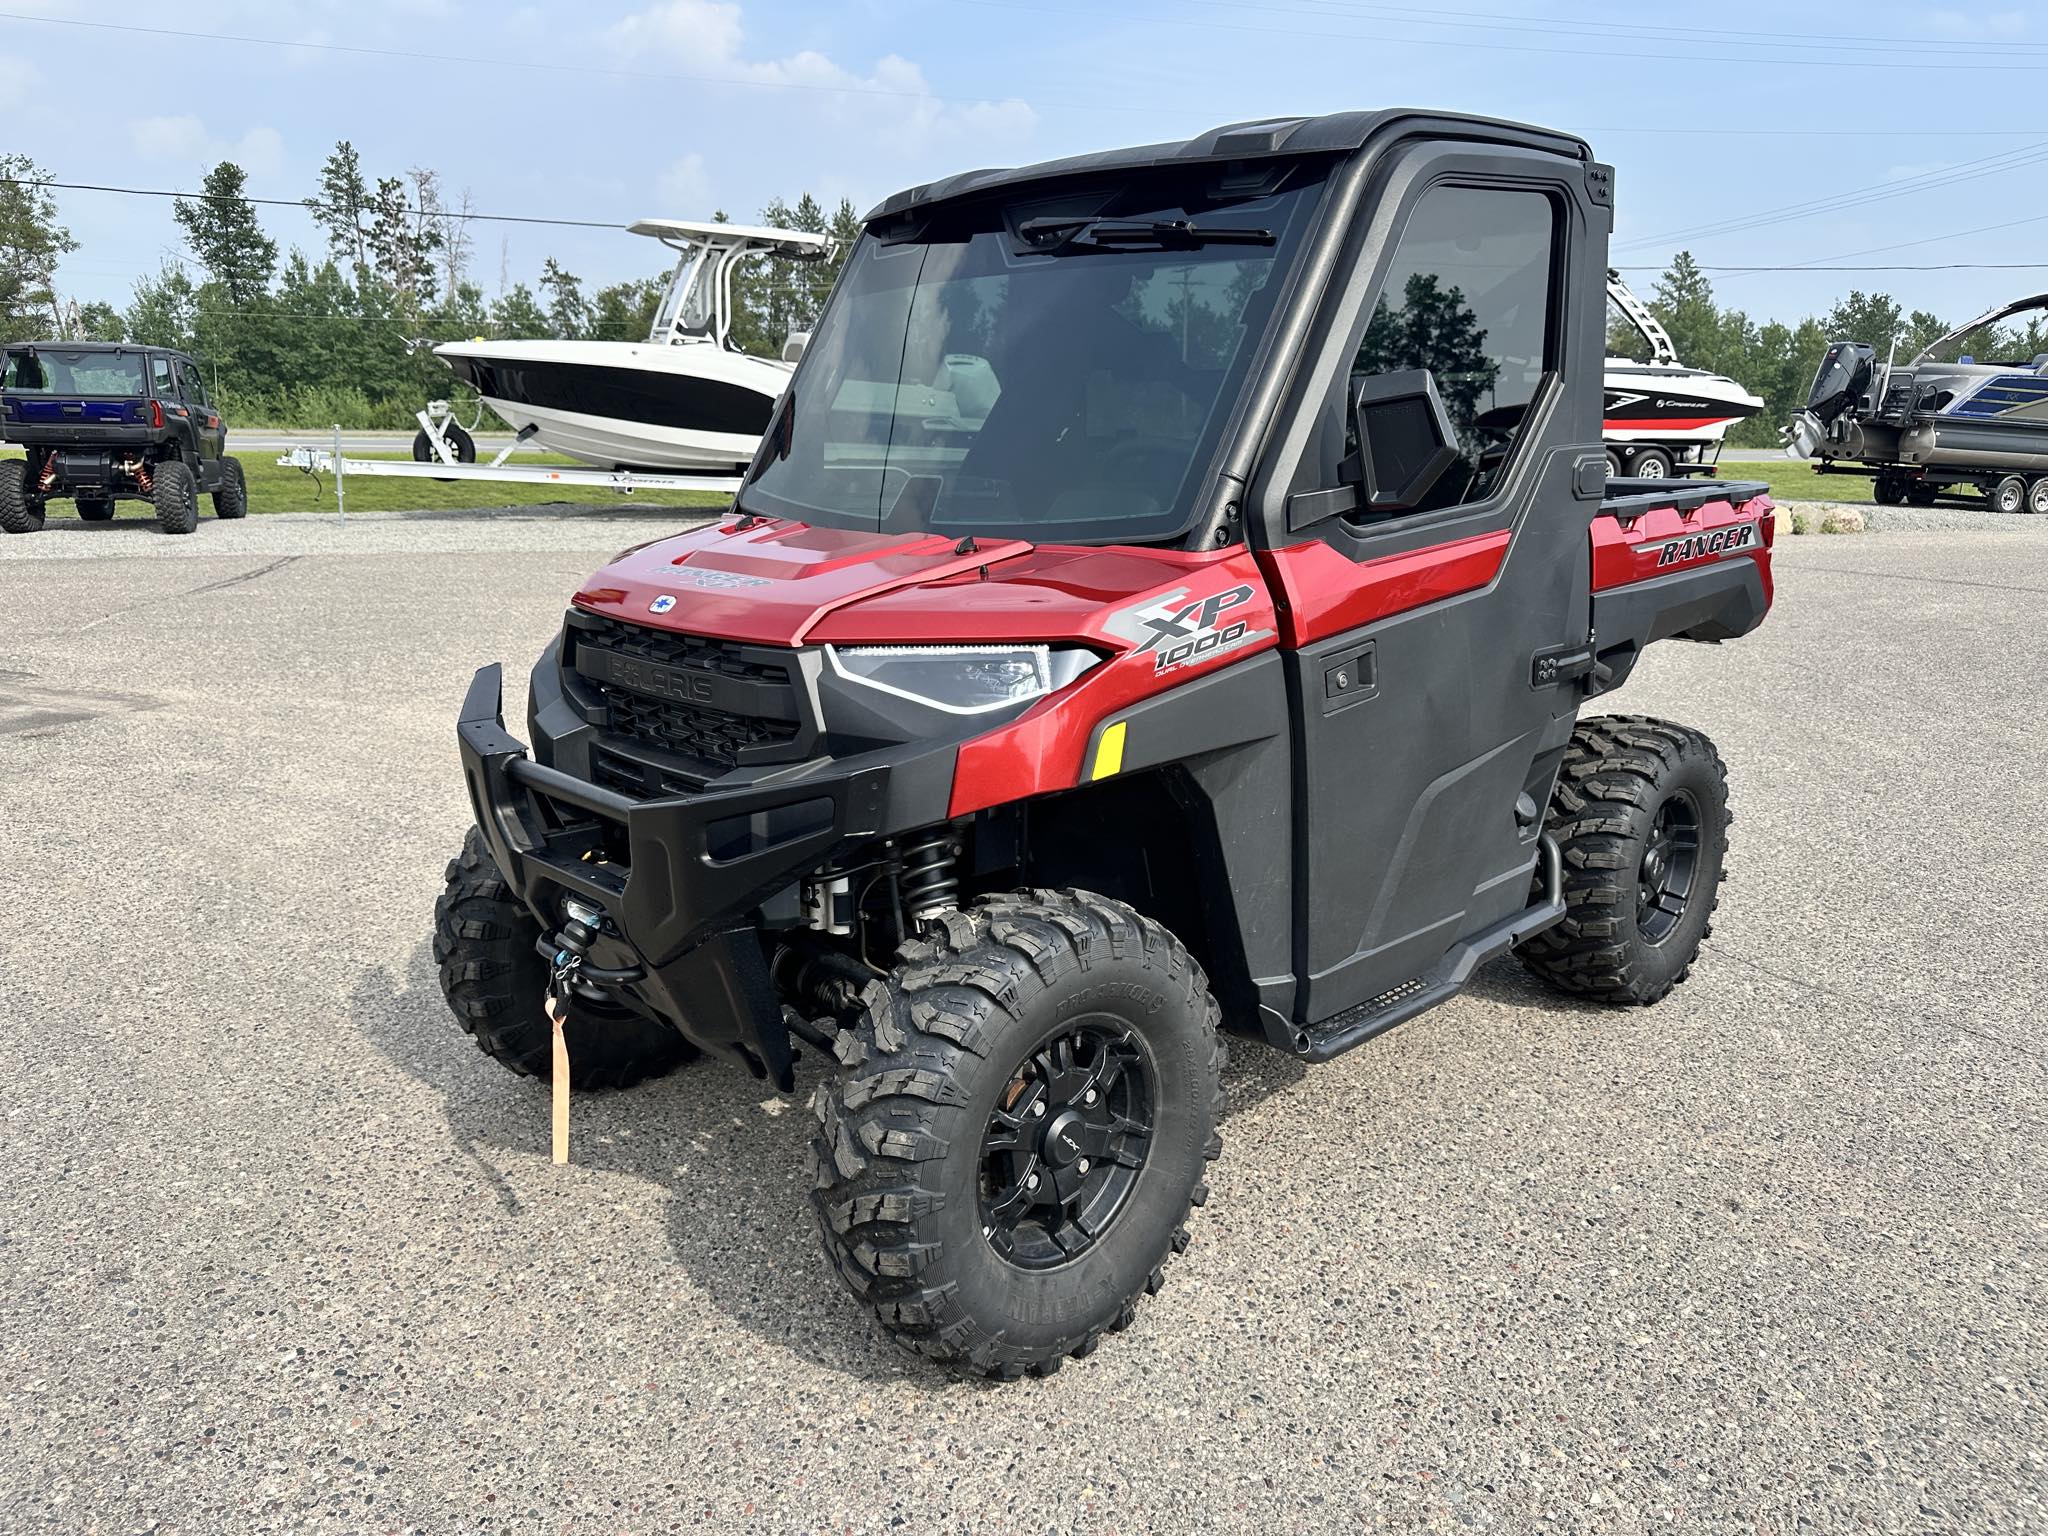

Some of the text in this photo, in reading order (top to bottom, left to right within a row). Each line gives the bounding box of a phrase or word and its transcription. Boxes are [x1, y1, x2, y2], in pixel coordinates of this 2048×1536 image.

[1658, 525, 1753, 567] RANGER
[1126, 584, 1256, 658] XP
[1154, 622, 1247, 672] 1000
[609, 656, 713, 704] POLARIS
[1155, 665, 1178, 678] DUAL
